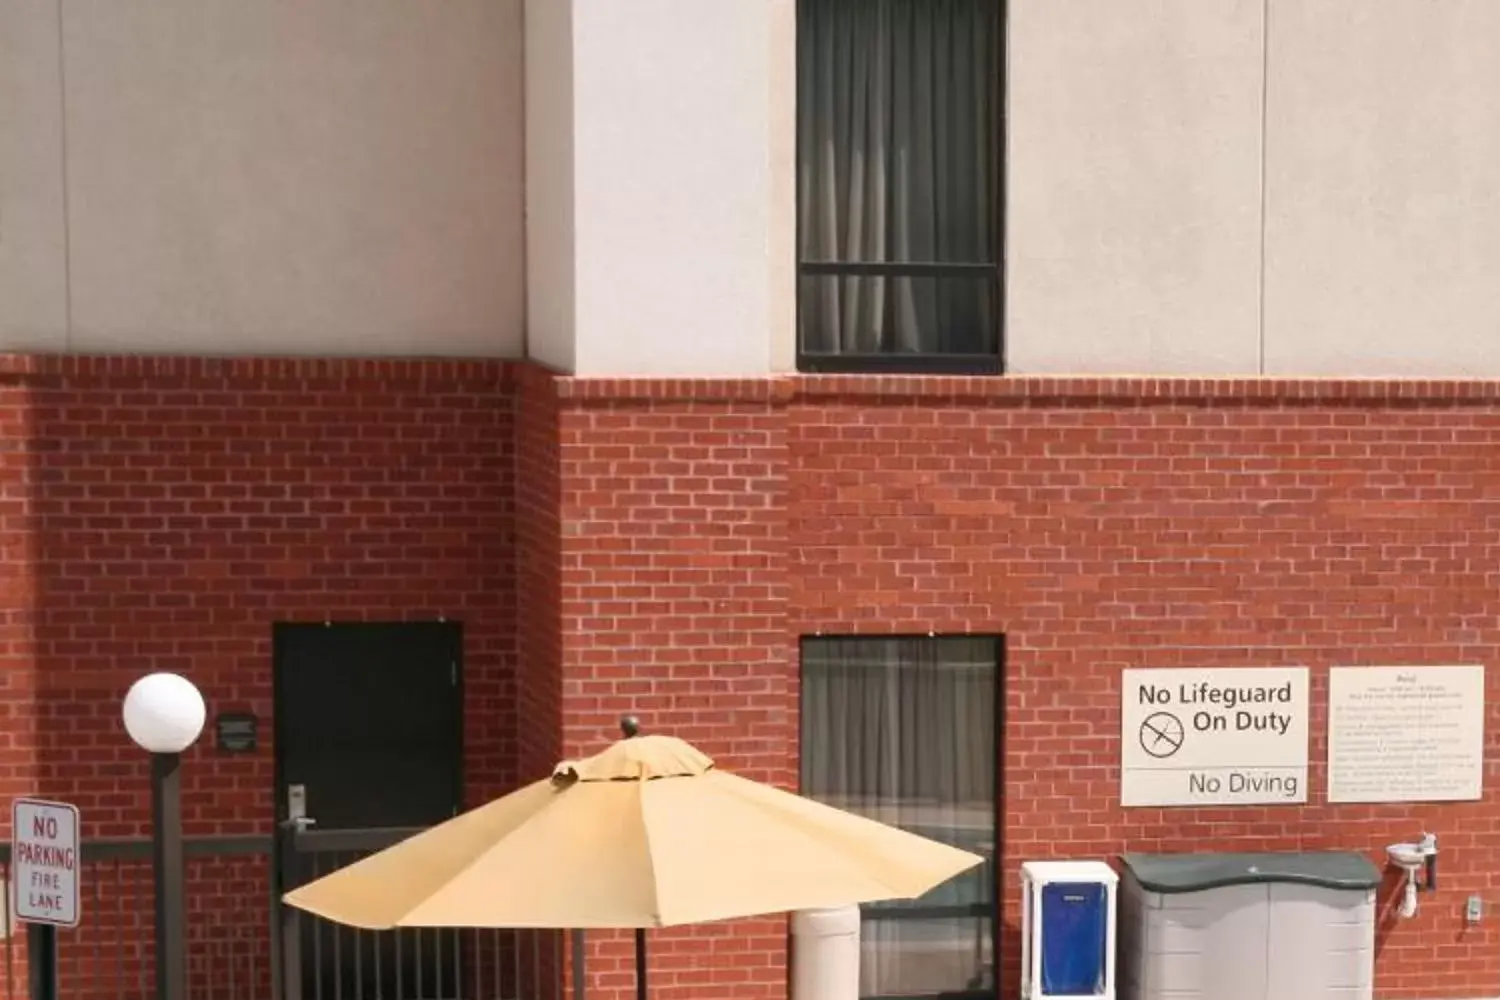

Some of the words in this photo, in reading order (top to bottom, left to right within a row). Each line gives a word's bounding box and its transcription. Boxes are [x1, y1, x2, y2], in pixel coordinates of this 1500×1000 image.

[1139, 684, 1171, 704] No
[1179, 681, 1292, 709] Lifeguard
[1193, 711, 1226, 731] On
[1236, 711, 1292, 736] Duty
[1189, 774, 1220, 793] No
[1229, 771, 1297, 797] Diving
[33, 815, 58, 839] NO
[17, 843, 74, 871] PARKING
[31, 871, 62, 890] FIRE
[28, 891, 63, 910] LANE
